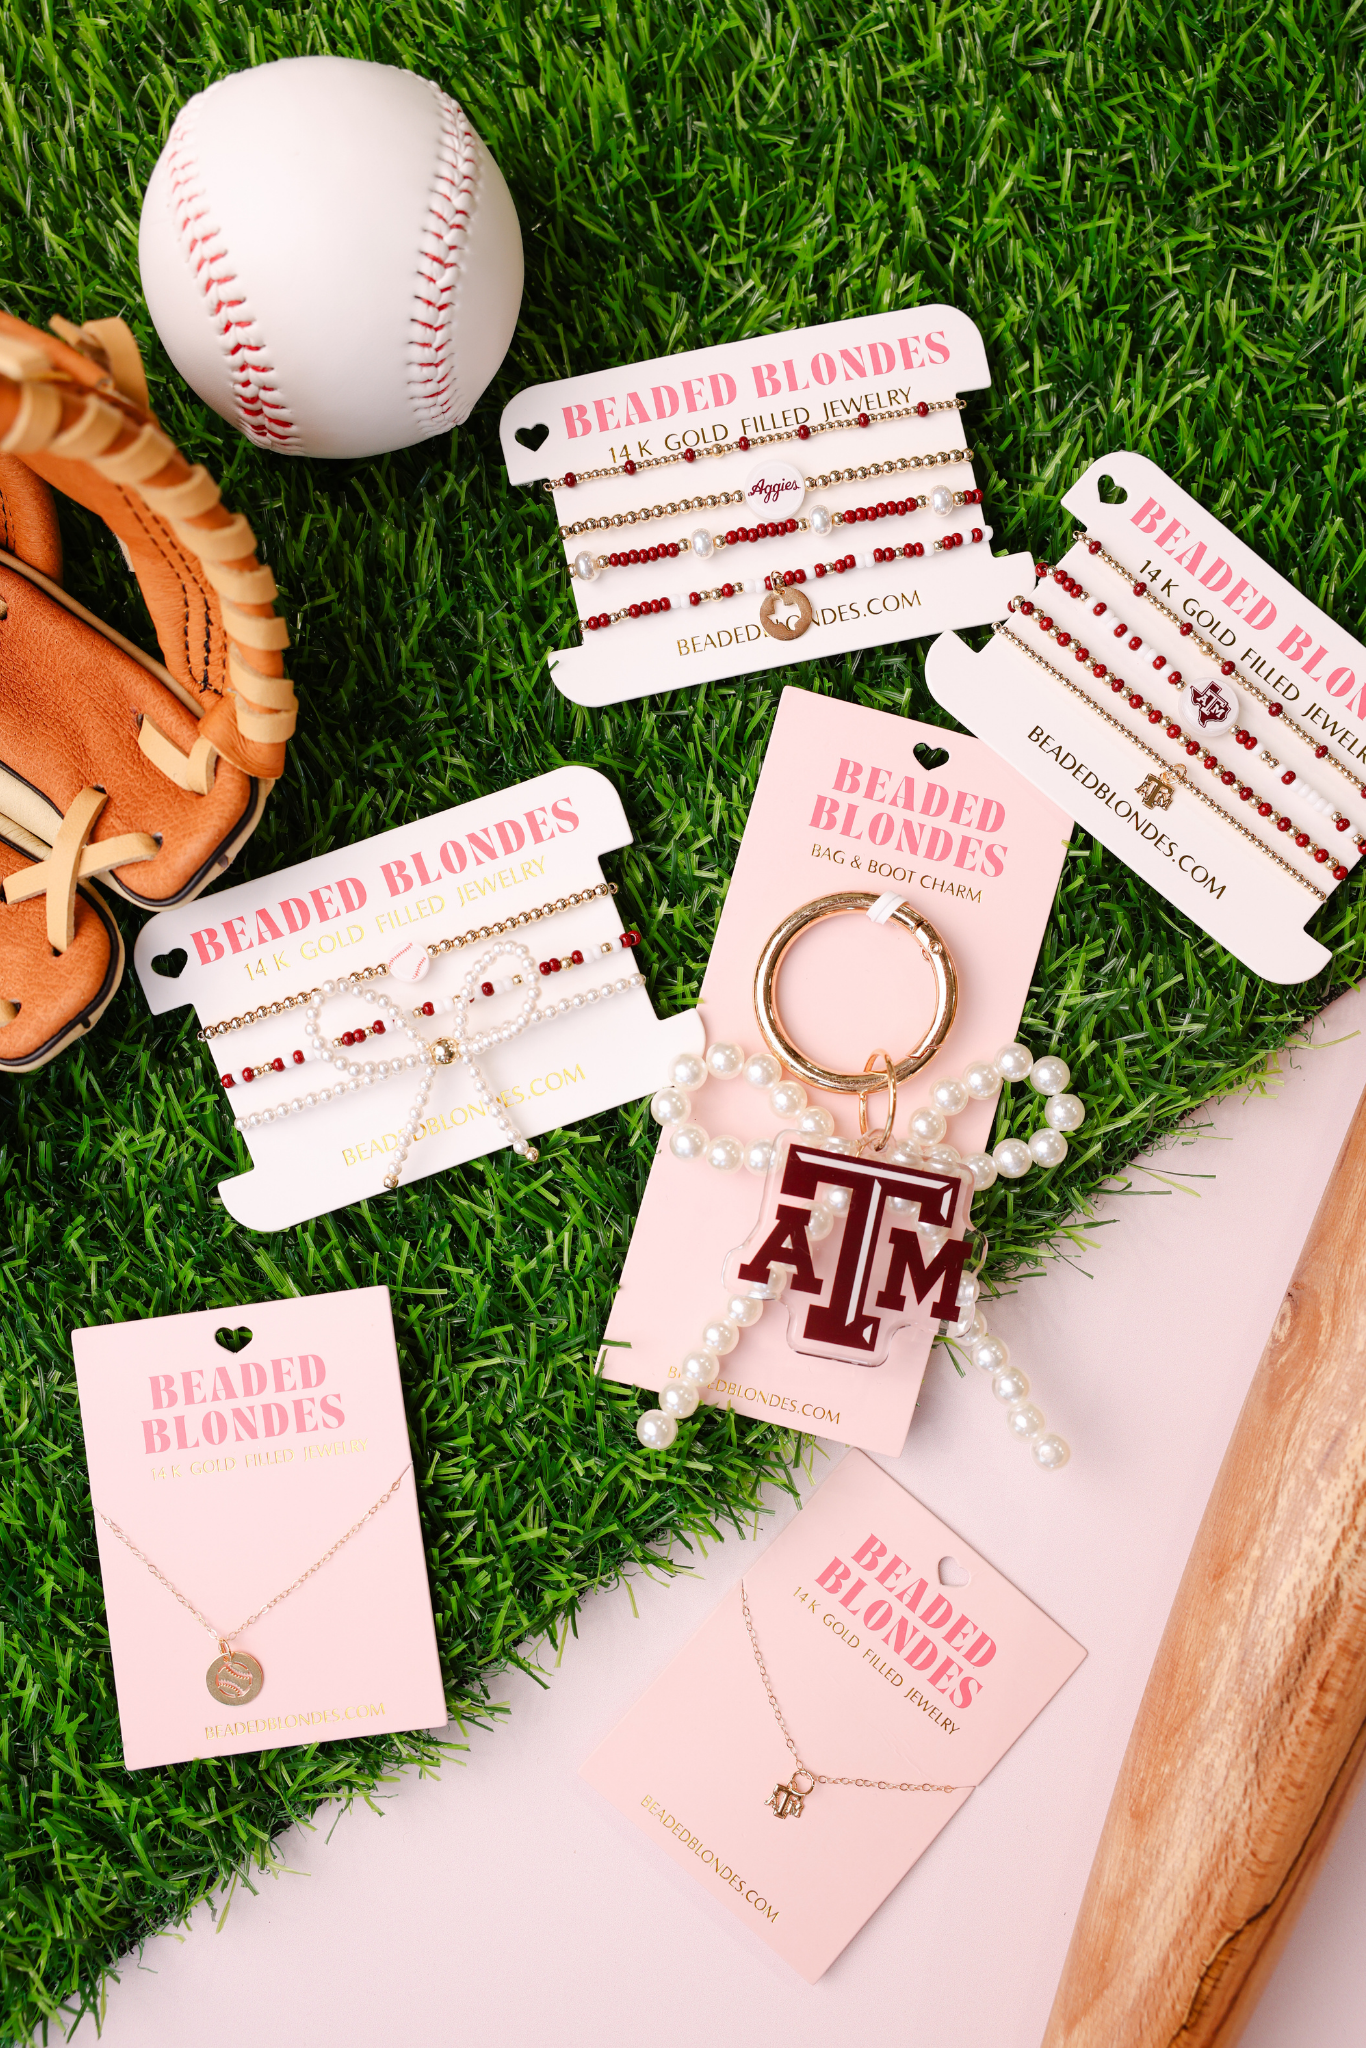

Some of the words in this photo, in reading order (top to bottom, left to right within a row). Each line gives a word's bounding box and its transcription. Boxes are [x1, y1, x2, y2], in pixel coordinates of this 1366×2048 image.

[561, 372, 737, 440] BEADED
[751, 331, 951, 398] BLONDES
[664, 424, 729, 451] GOLD
[741, 407, 810, 436] FILLED
[824, 387, 912, 421] JEWELRY
[747, 478, 801, 503] Aggies
[1129, 496, 1278, 631] BEADED
[677, 590, 922, 656] BEADEDONDES.COM
[1139, 559, 1162, 582] 14
[1161, 578, 1180, 598] K
[1183, 597, 1236, 647] GOLD
[1240, 647, 1300, 701] FILLED
[809, 794, 1009, 878] BLONDES
[831, 757, 1006, 834] BEADED
[1028, 725, 1227, 900] BEADEDBLONDES.COM
[189, 876, 367, 966] BEADED
[380, 796, 581, 897] BLONDES
[243, 960, 269, 981] 14
[275, 952, 291, 972] K
[300, 924, 365, 960] GOLD
[375, 894, 445, 934] FILLED
[457, 856, 548, 908] JEWELRY
[811, 843, 846, 865] BAG
[850, 855, 863, 869] &
[867, 859, 917, 884] BOOT
[919, 874, 983, 904] CHARM
[342, 1063, 586, 1167] BEADDBLONES.COM
[140, 1393, 345, 1454] BLONDES
[148, 1354, 327, 1410] BEADED
[190, 1456, 236, 1476] GOLD
[245, 1448, 295, 1468] FILLED
[304, 1438, 369, 1462] JEWELRY
[814, 1556, 983, 1710] BLONDES
[850, 1533, 997, 1669] BEADED
[205, 1702, 386, 1740] BEADEDBLONDES.COM
[823, 1613, 860, 1649] GOLD
[863, 1648, 904, 1688] FILLED
[903, 1687, 961, 1736] JEWELRY
[641, 1794, 780, 1924] BEADEDBLONDES.COM
